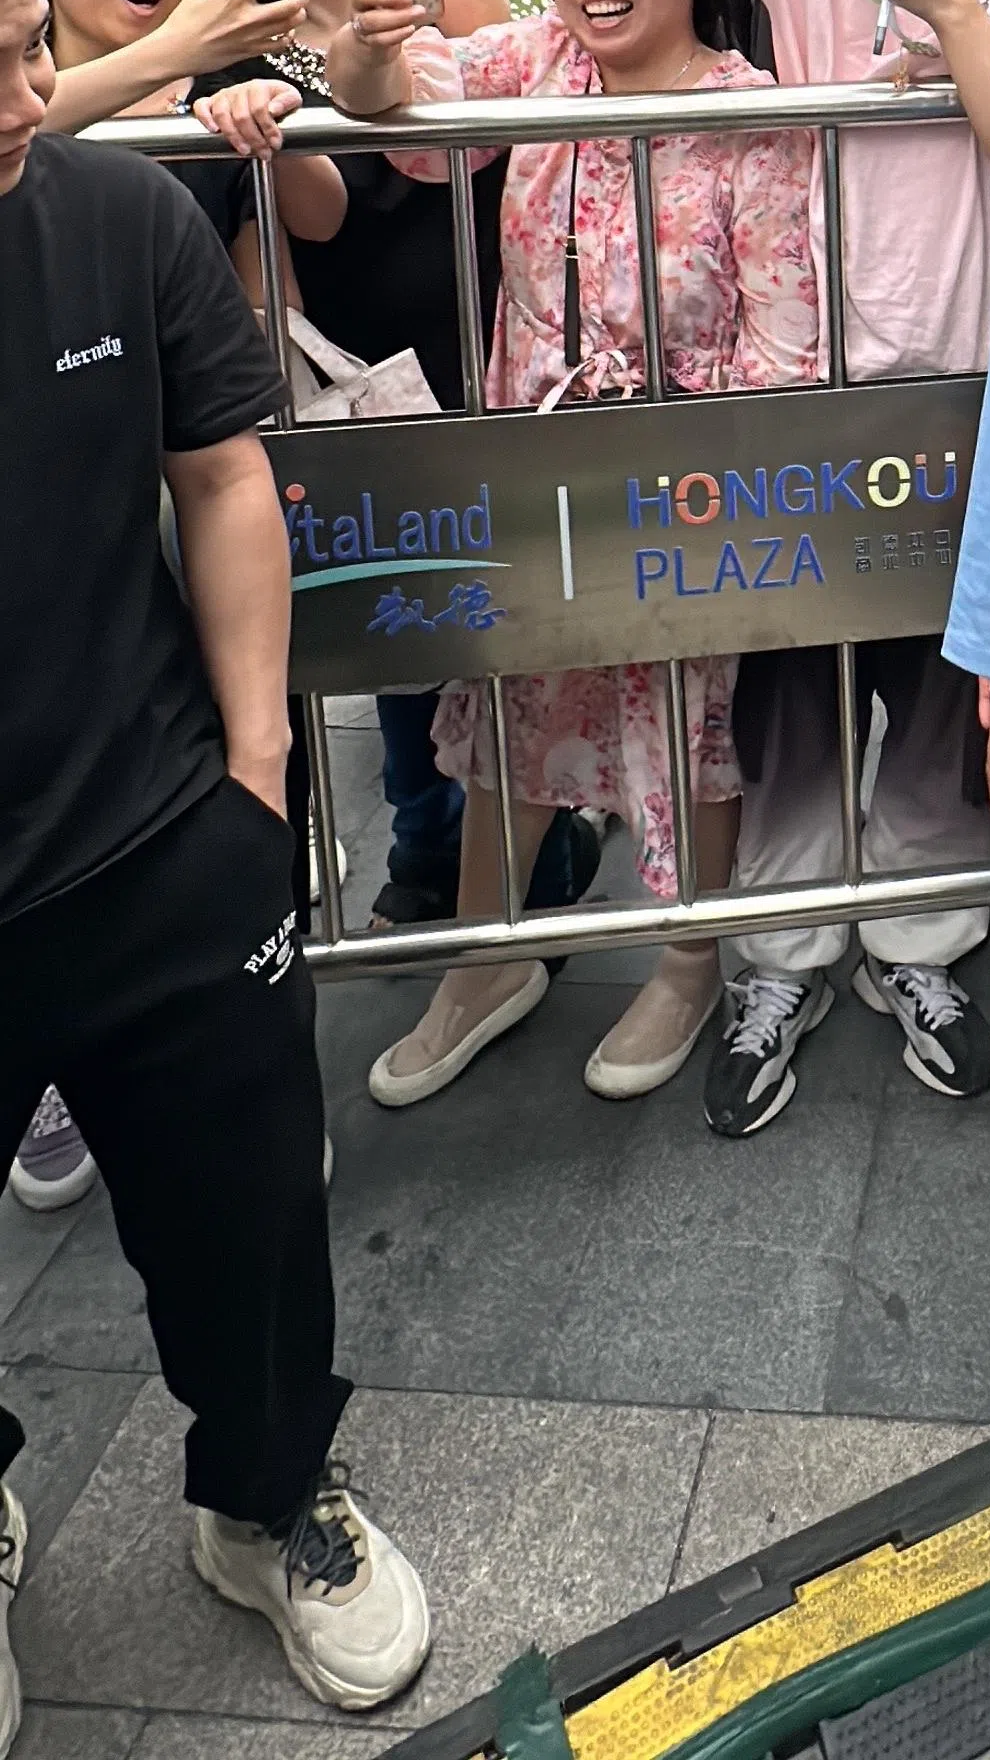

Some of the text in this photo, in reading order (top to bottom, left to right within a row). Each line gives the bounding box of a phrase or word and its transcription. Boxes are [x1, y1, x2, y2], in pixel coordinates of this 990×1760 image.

[56, 335, 123, 372] eternity
[626, 451, 957, 529] HONGKOU
[635, 533, 826, 601] PLAZA
